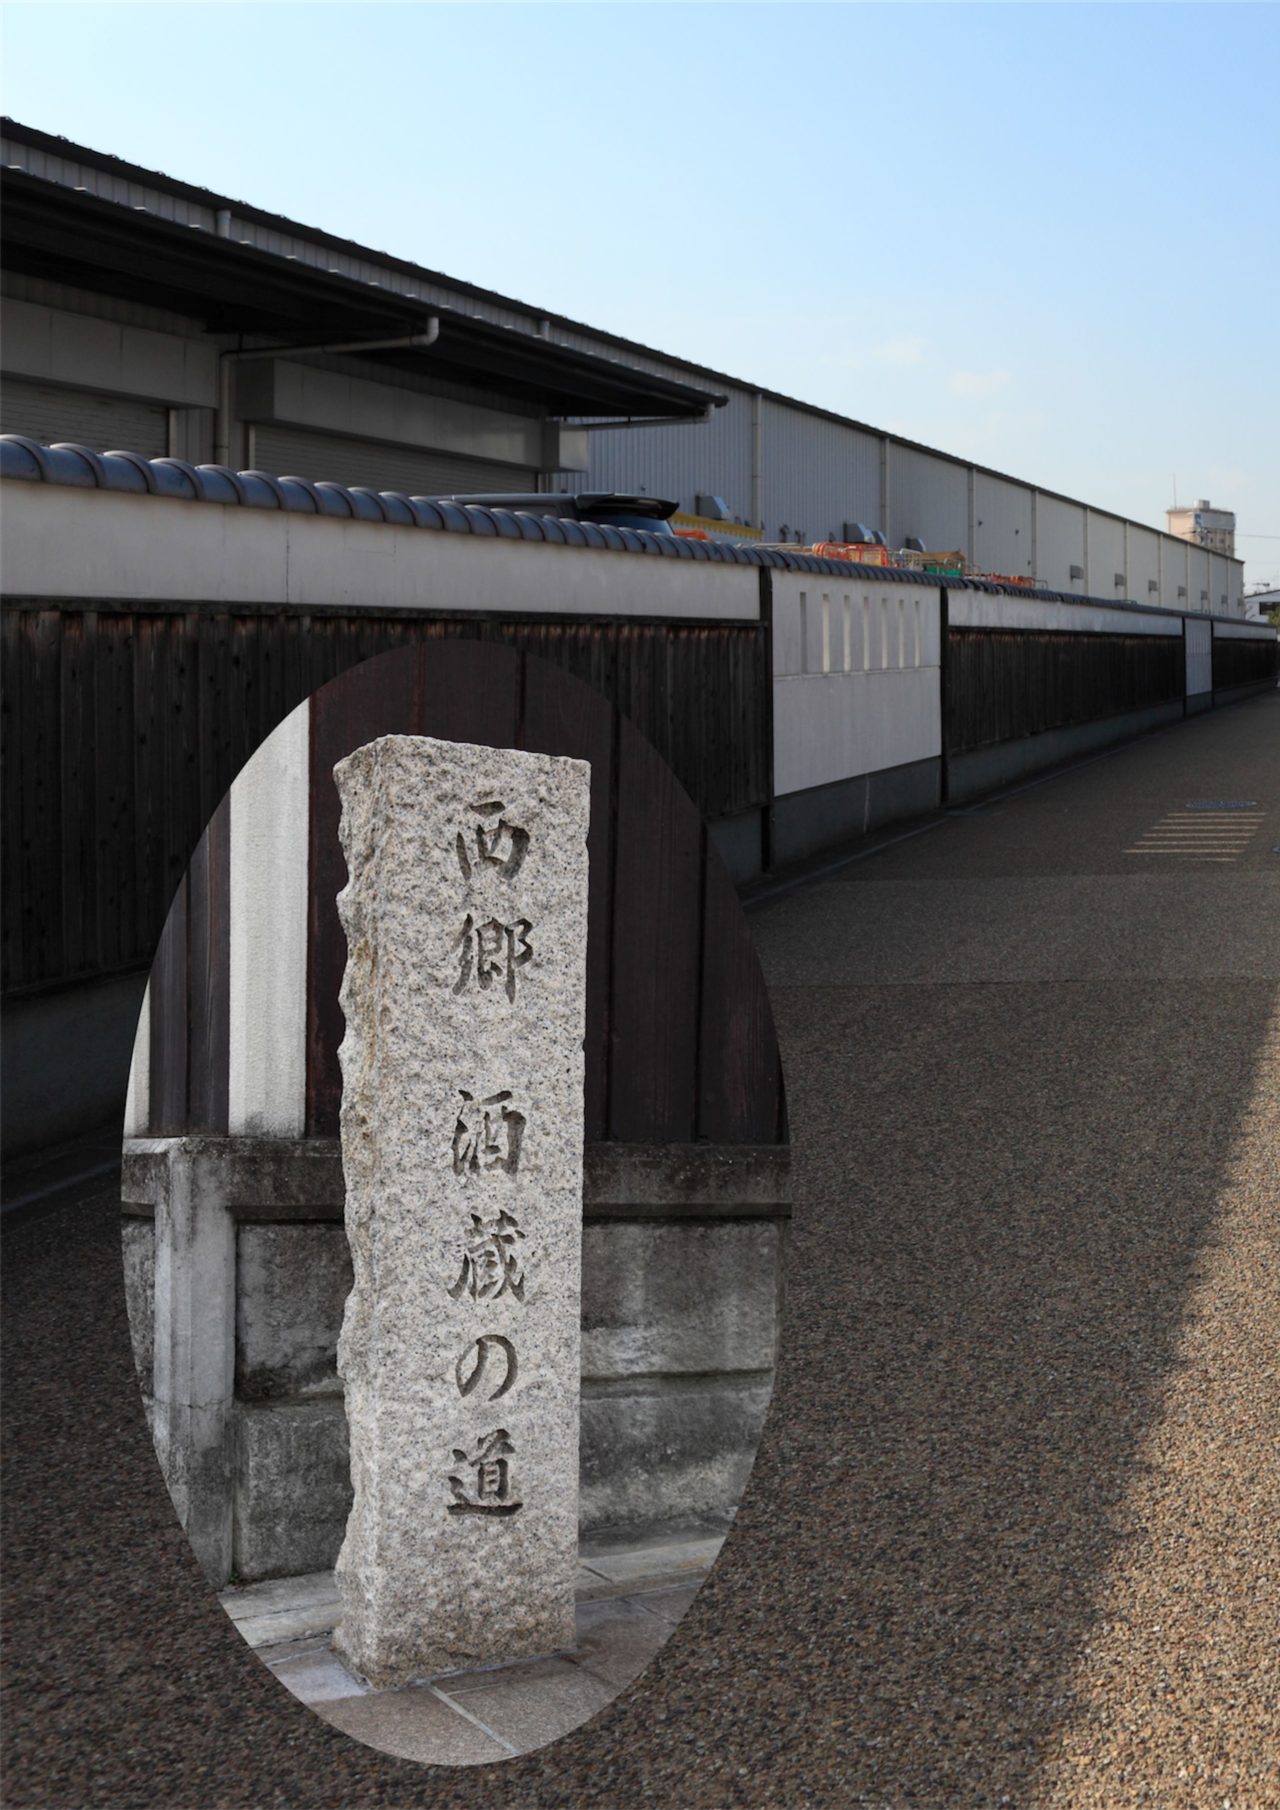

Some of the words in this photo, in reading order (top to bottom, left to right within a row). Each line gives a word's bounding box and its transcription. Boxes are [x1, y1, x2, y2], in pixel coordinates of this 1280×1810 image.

[450, 799, 535, 1005] 西郷
[446, 1088, 528, 1518] 酒蔵の道
